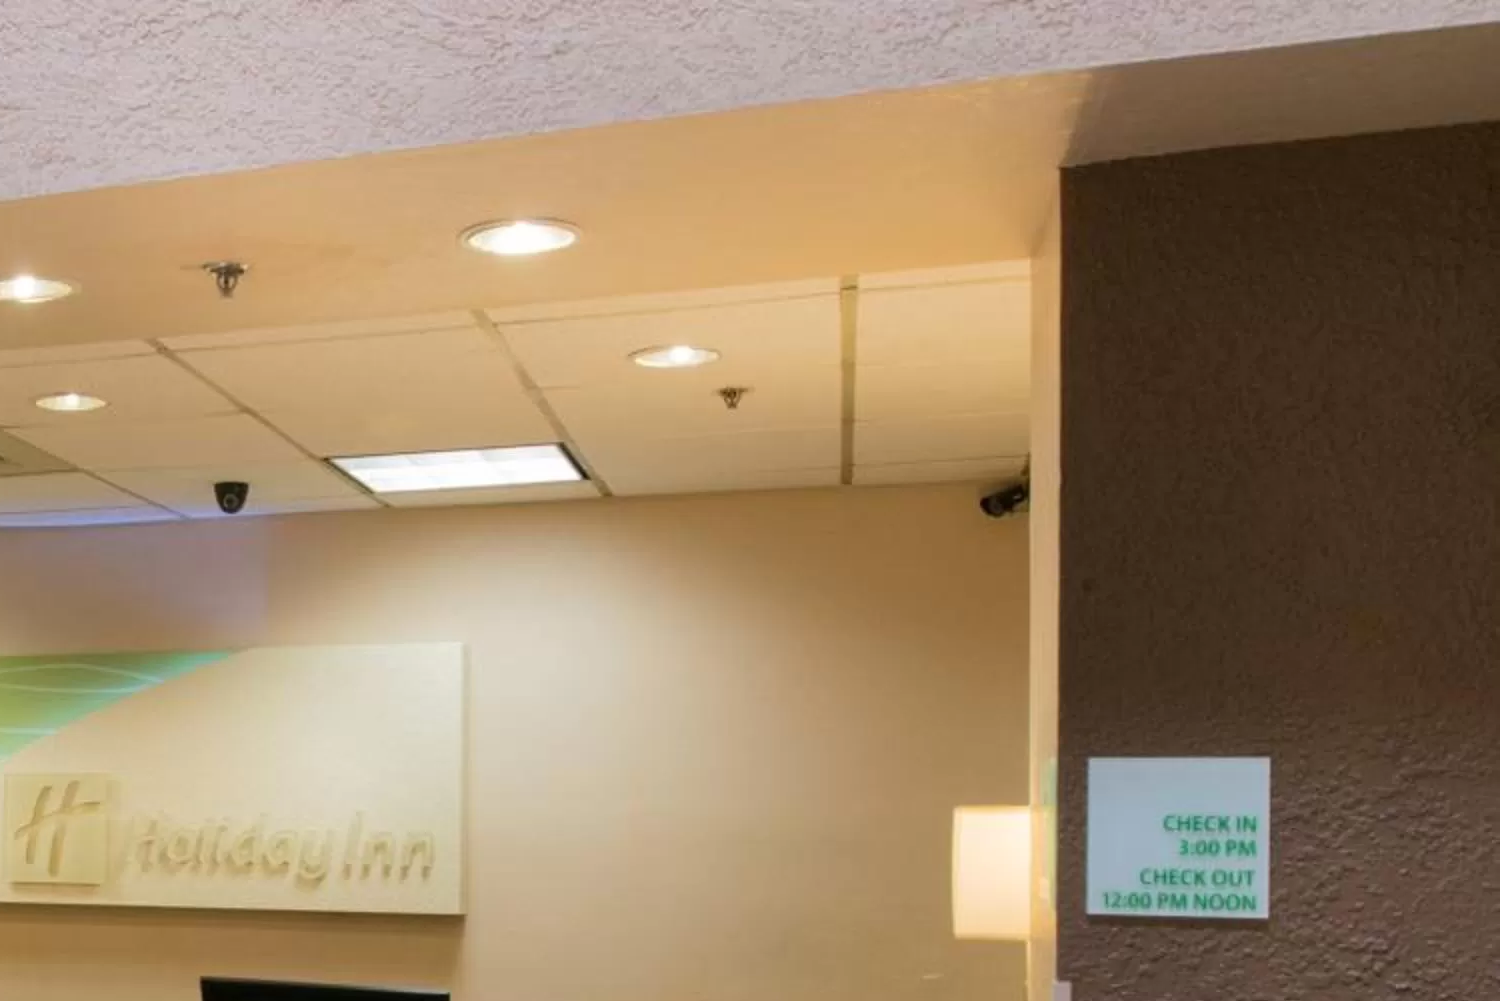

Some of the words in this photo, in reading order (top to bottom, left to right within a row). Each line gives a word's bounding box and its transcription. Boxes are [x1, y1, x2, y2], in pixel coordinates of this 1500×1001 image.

[1163, 815, 1230, 832] CHECK
[1236, 815, 1257, 832] IN
[1179, 839, 1221, 856] 3:00
[1225, 839, 1257, 856] PM
[1139, 868, 1206, 886] CHECK
[1211, 869, 1256, 887] OUT
[1103, 892, 1152, 910] 12:00
[1157, 892, 1188, 910] PM
[1193, 893, 1257, 912] NOON
